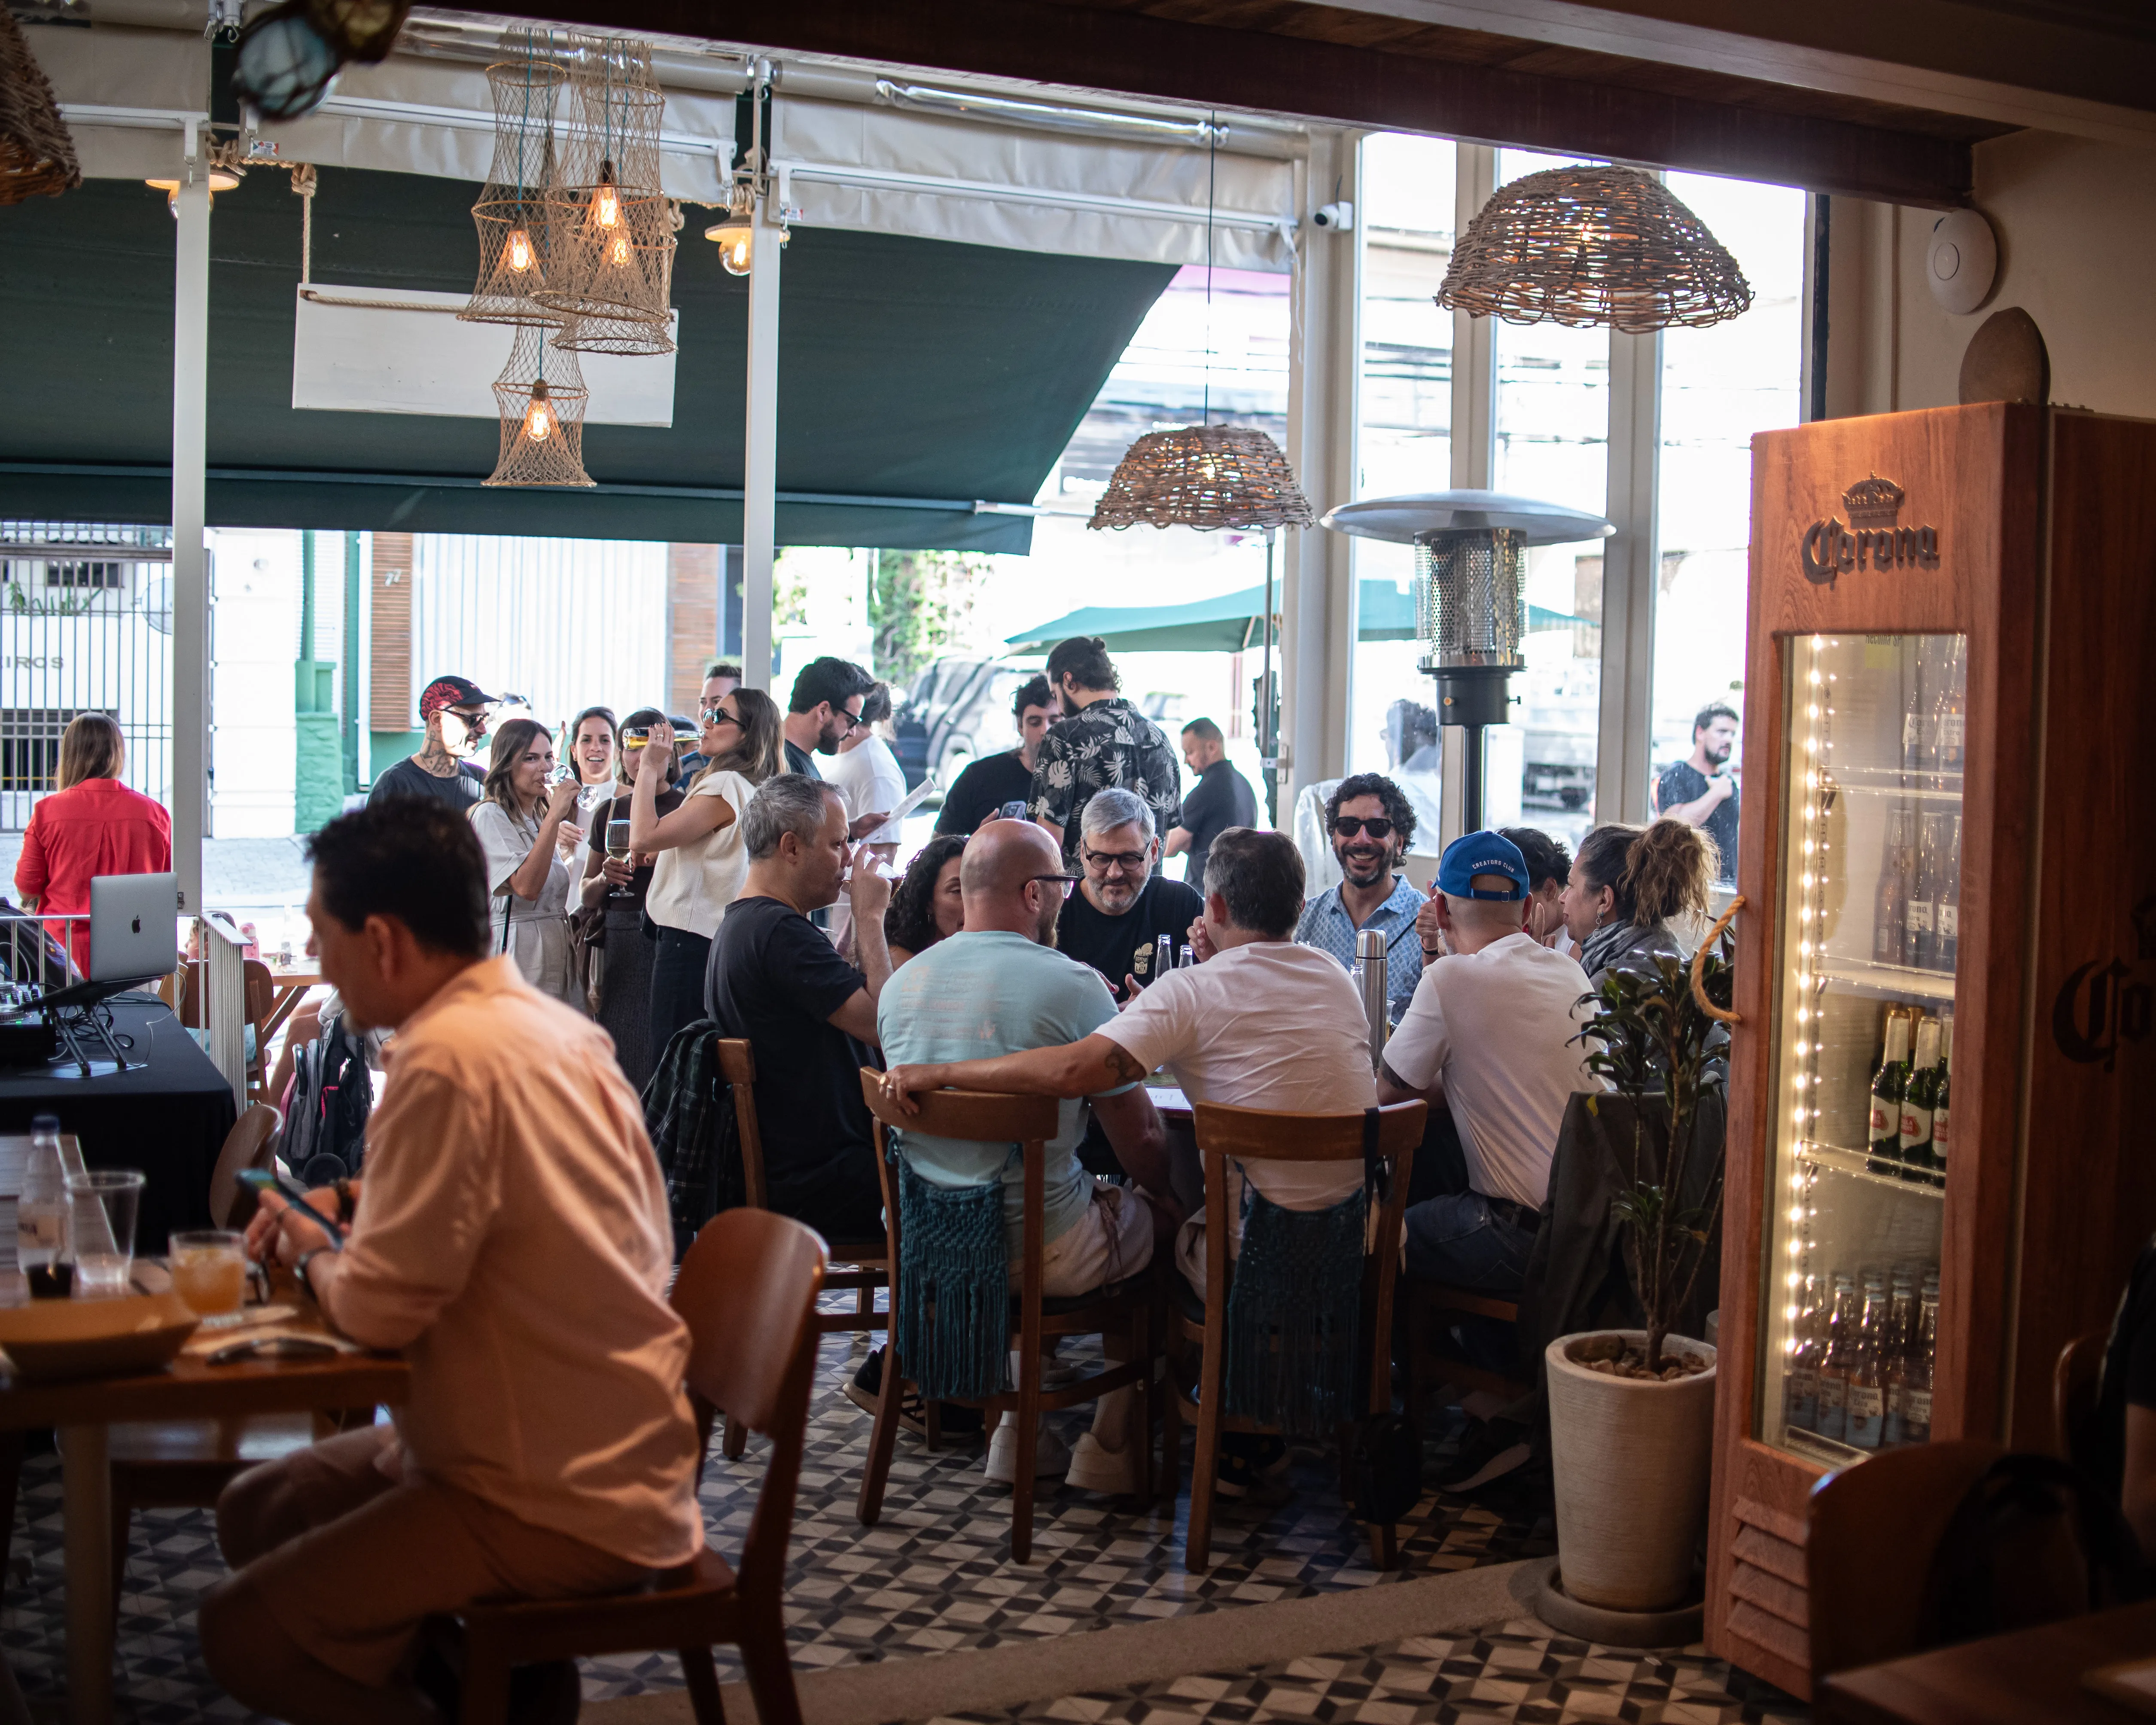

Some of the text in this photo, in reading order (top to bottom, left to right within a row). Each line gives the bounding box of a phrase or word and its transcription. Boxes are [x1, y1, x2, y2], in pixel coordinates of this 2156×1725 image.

[1801, 515, 1940, 587] Corona
[0, 656, 64, 669] IROS
[1472, 859, 1514, 873] CREATORS CLUB
